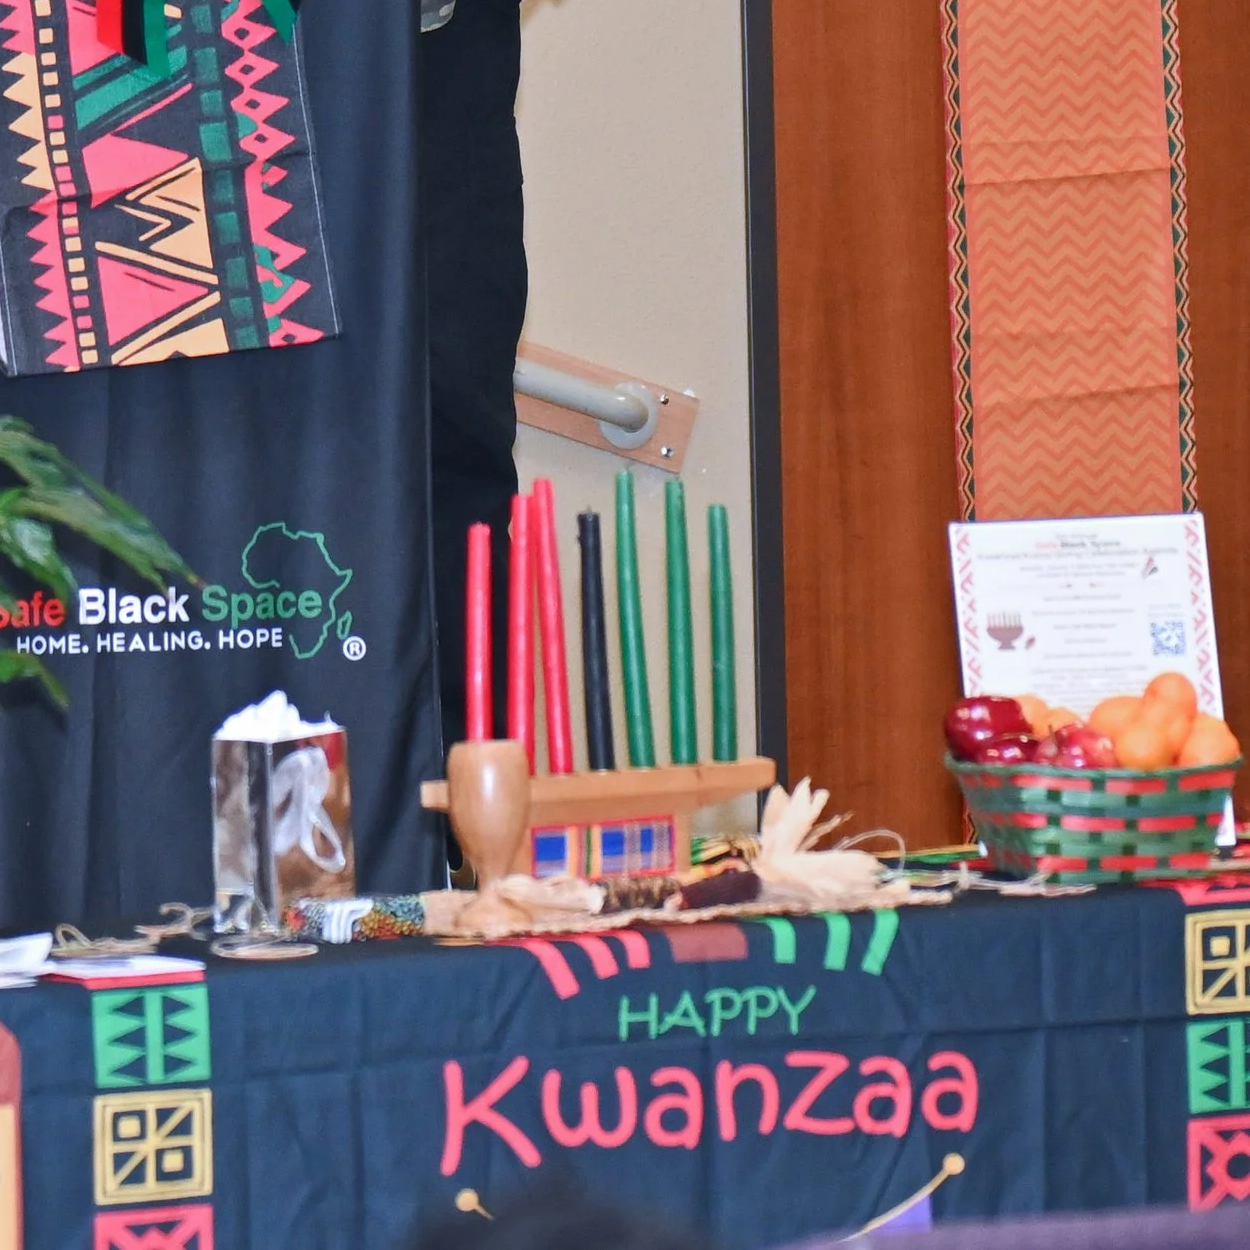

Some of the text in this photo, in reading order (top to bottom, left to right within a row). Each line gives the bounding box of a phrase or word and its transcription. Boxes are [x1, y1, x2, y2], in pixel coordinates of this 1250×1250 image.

[79, 587, 190, 626] Black
[202, 585, 324, 629] Space
[16, 633, 89, 655] HOME.
[96, 630, 212, 653] HEALING.
[219, 628, 283, 650] HOPE
[618, 985, 816, 1042] HAPPY
[439, 1049, 979, 1176] Kwanzaa
